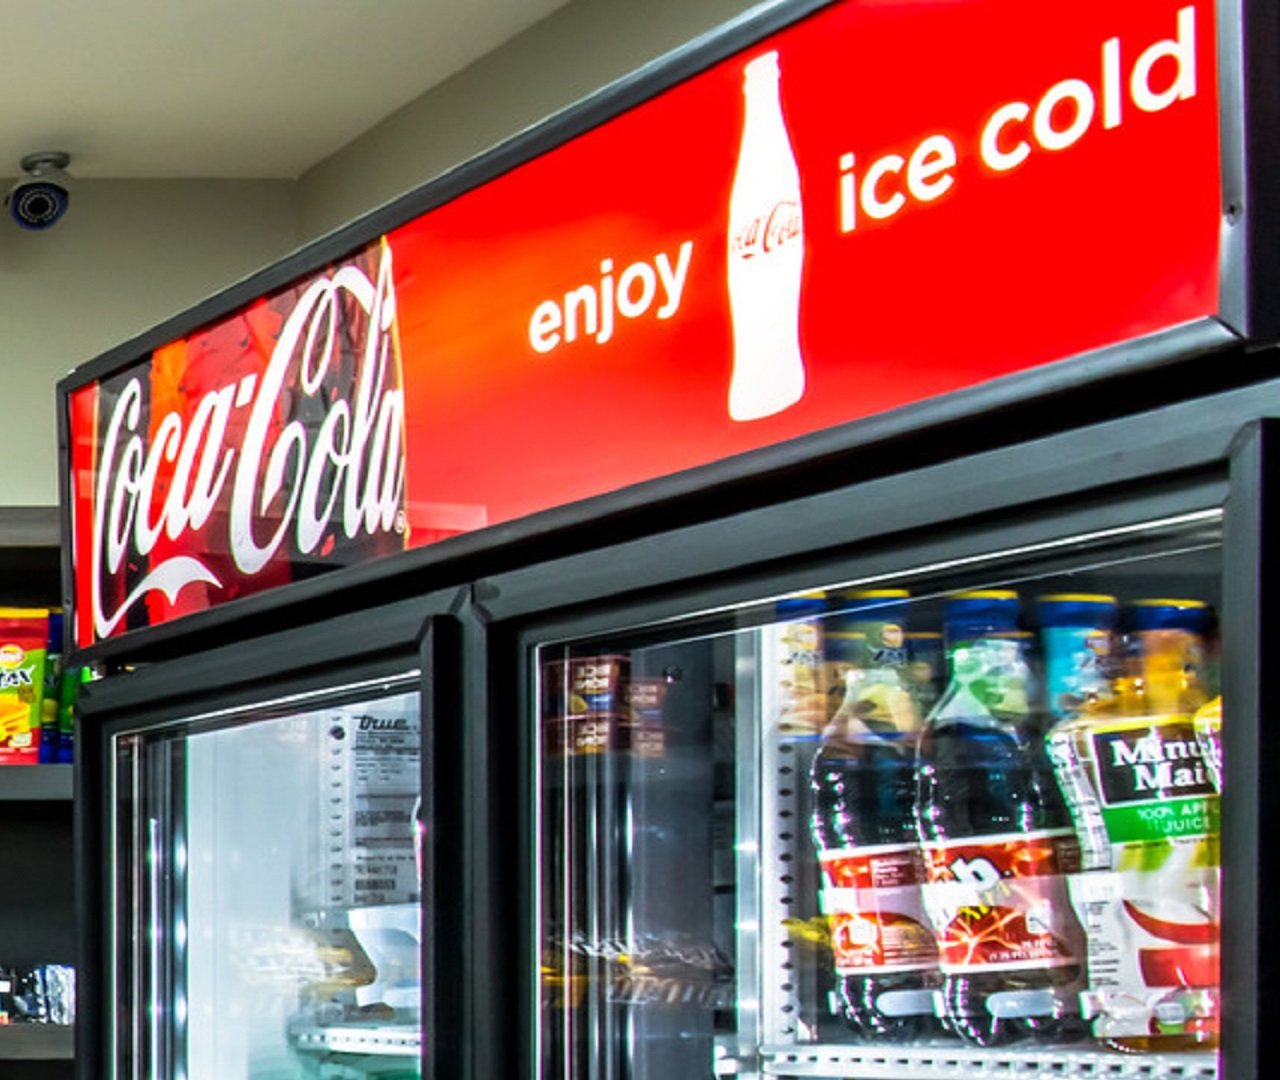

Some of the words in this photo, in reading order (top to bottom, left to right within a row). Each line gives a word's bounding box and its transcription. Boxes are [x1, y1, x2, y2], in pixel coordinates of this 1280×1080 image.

[840, 134, 957, 233] ice
[980, 5, 1196, 171] cold
[527, 241, 693, 352] enjoy
[93, 246, 405, 639] Coca-Cola
[1133, 761, 1206, 791] Mai
